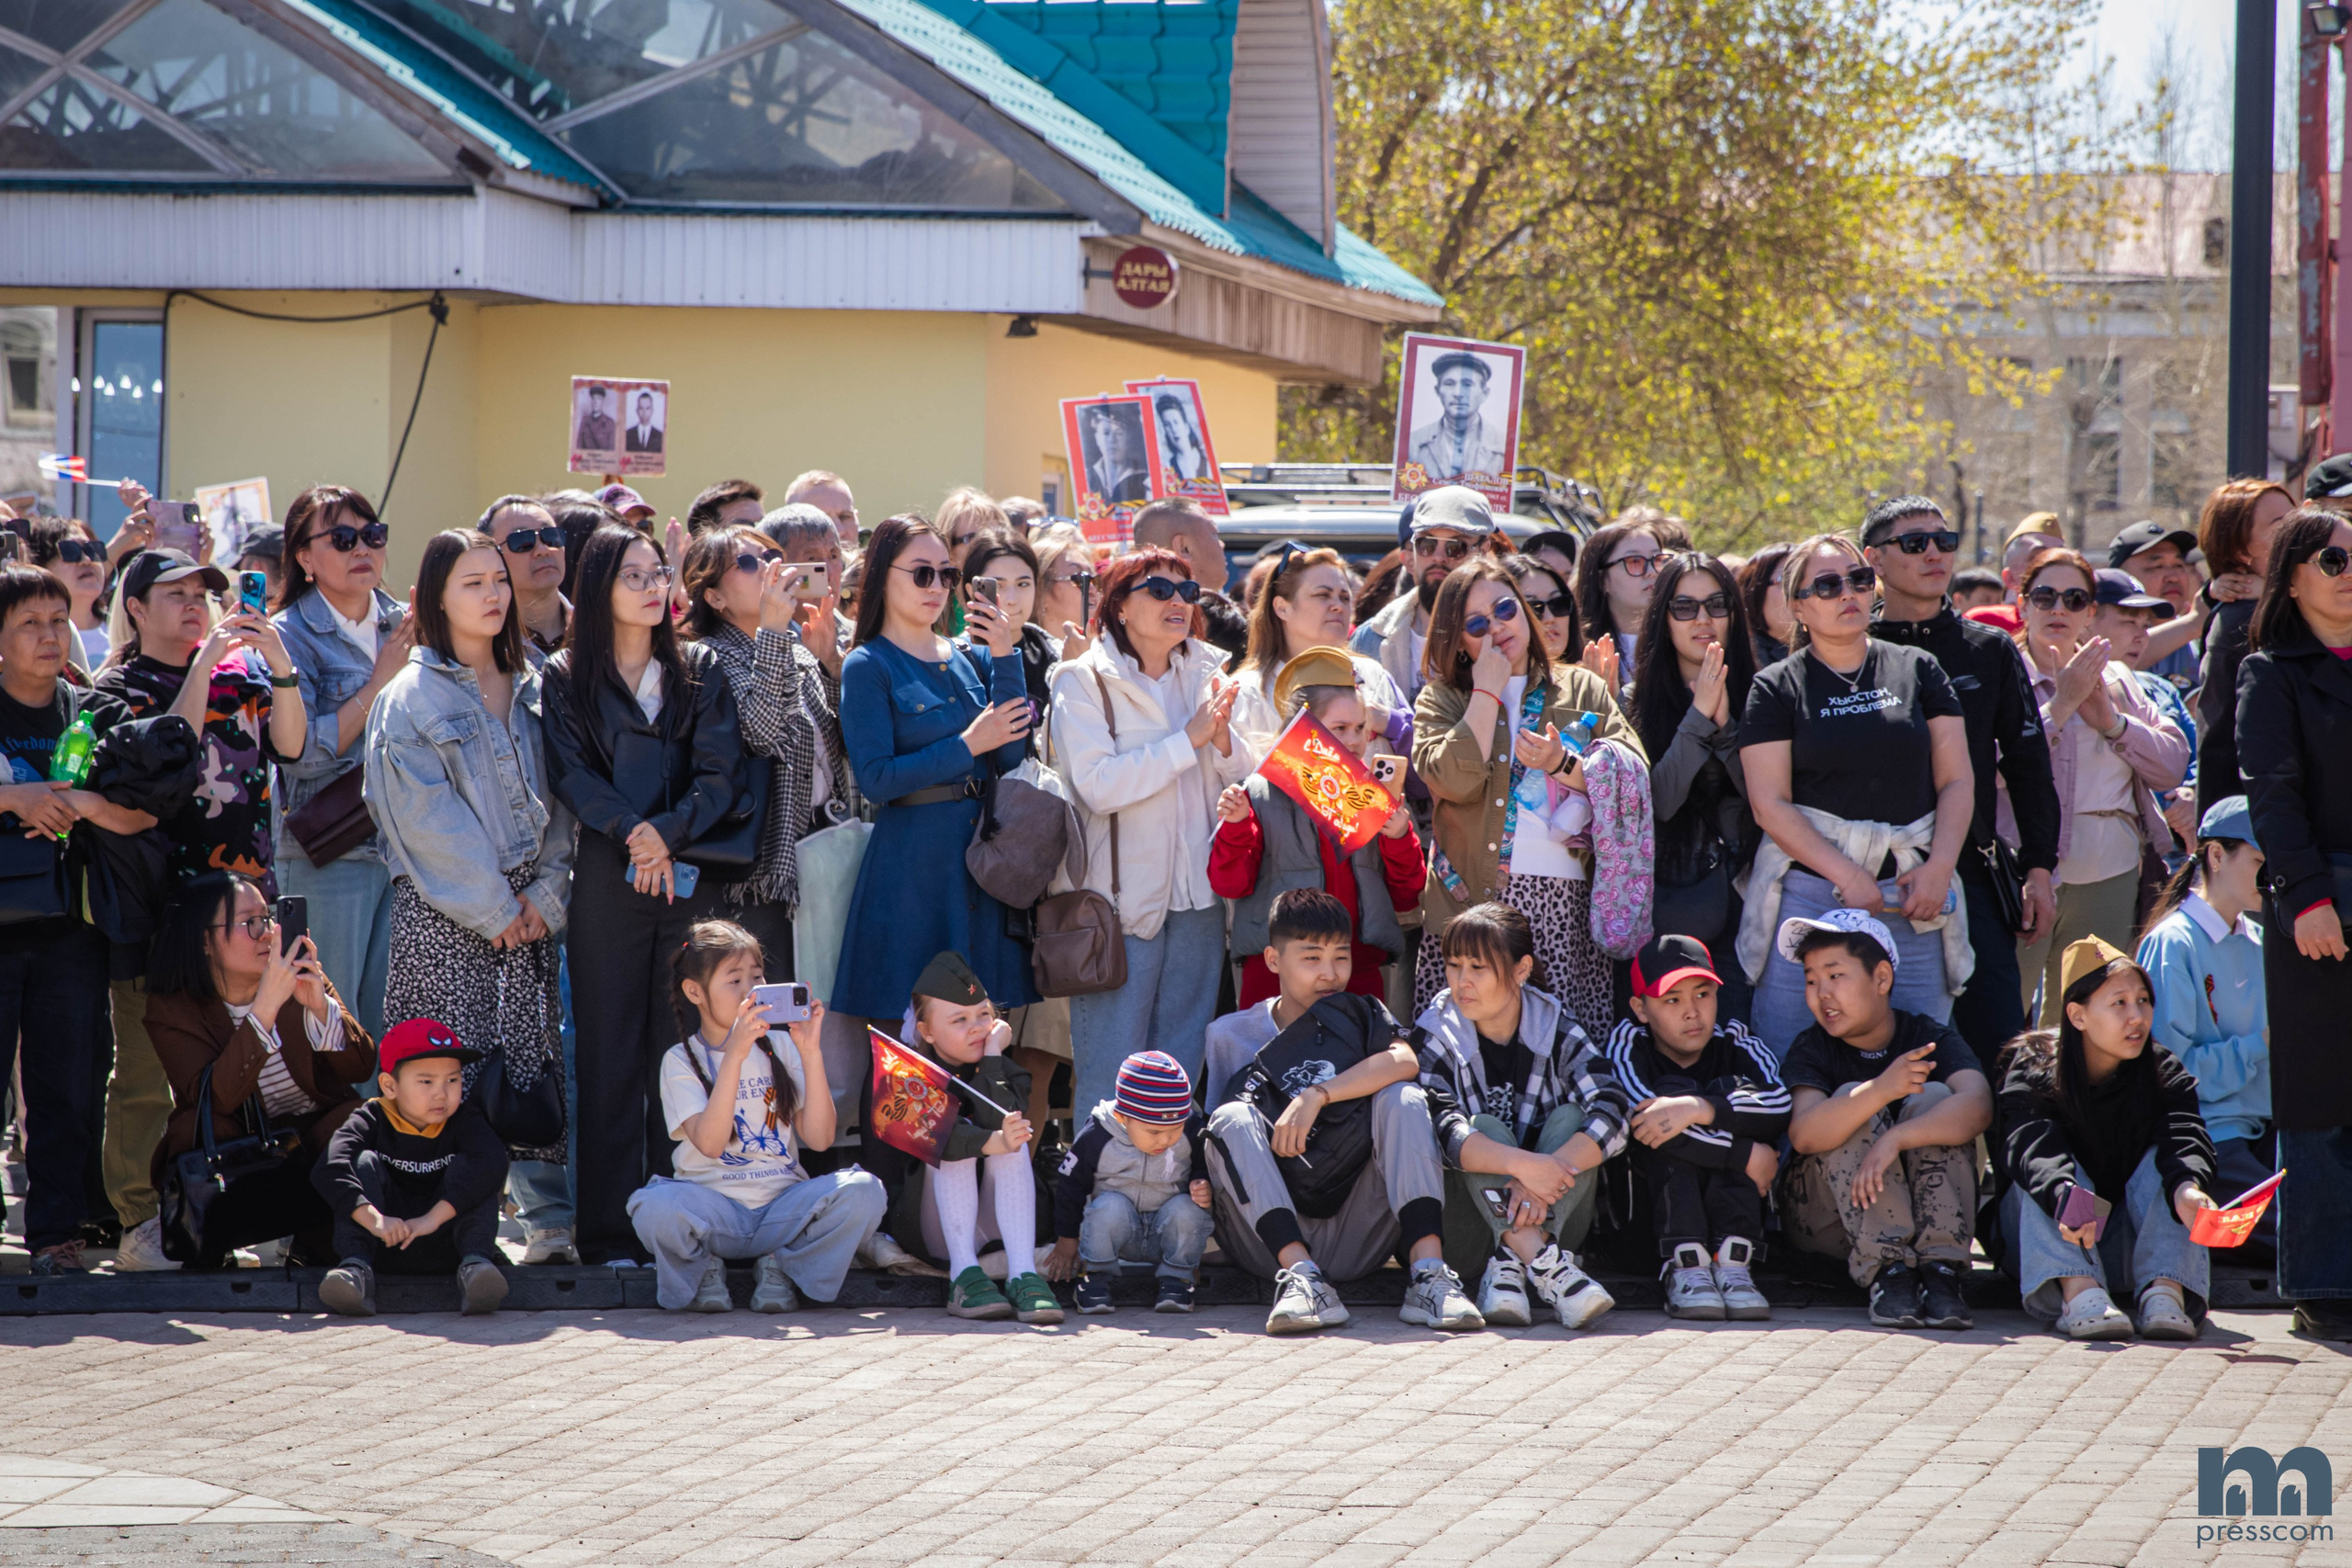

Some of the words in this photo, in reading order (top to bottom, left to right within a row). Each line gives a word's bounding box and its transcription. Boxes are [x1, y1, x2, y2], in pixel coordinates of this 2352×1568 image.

[1120, 261, 1168, 277] ДАРЫ
[1116, 276, 1170, 293] АЛТАЯ
[1828, 686, 1892, 705] ХЬЮСТОН,
[1820, 707, 1831, 718] Я
[1833, 695, 1903, 716] ПРОБЛЕМА
[722, 1172, 747, 1180] GOOD
[749, 1168, 779, 1179] THINGS
